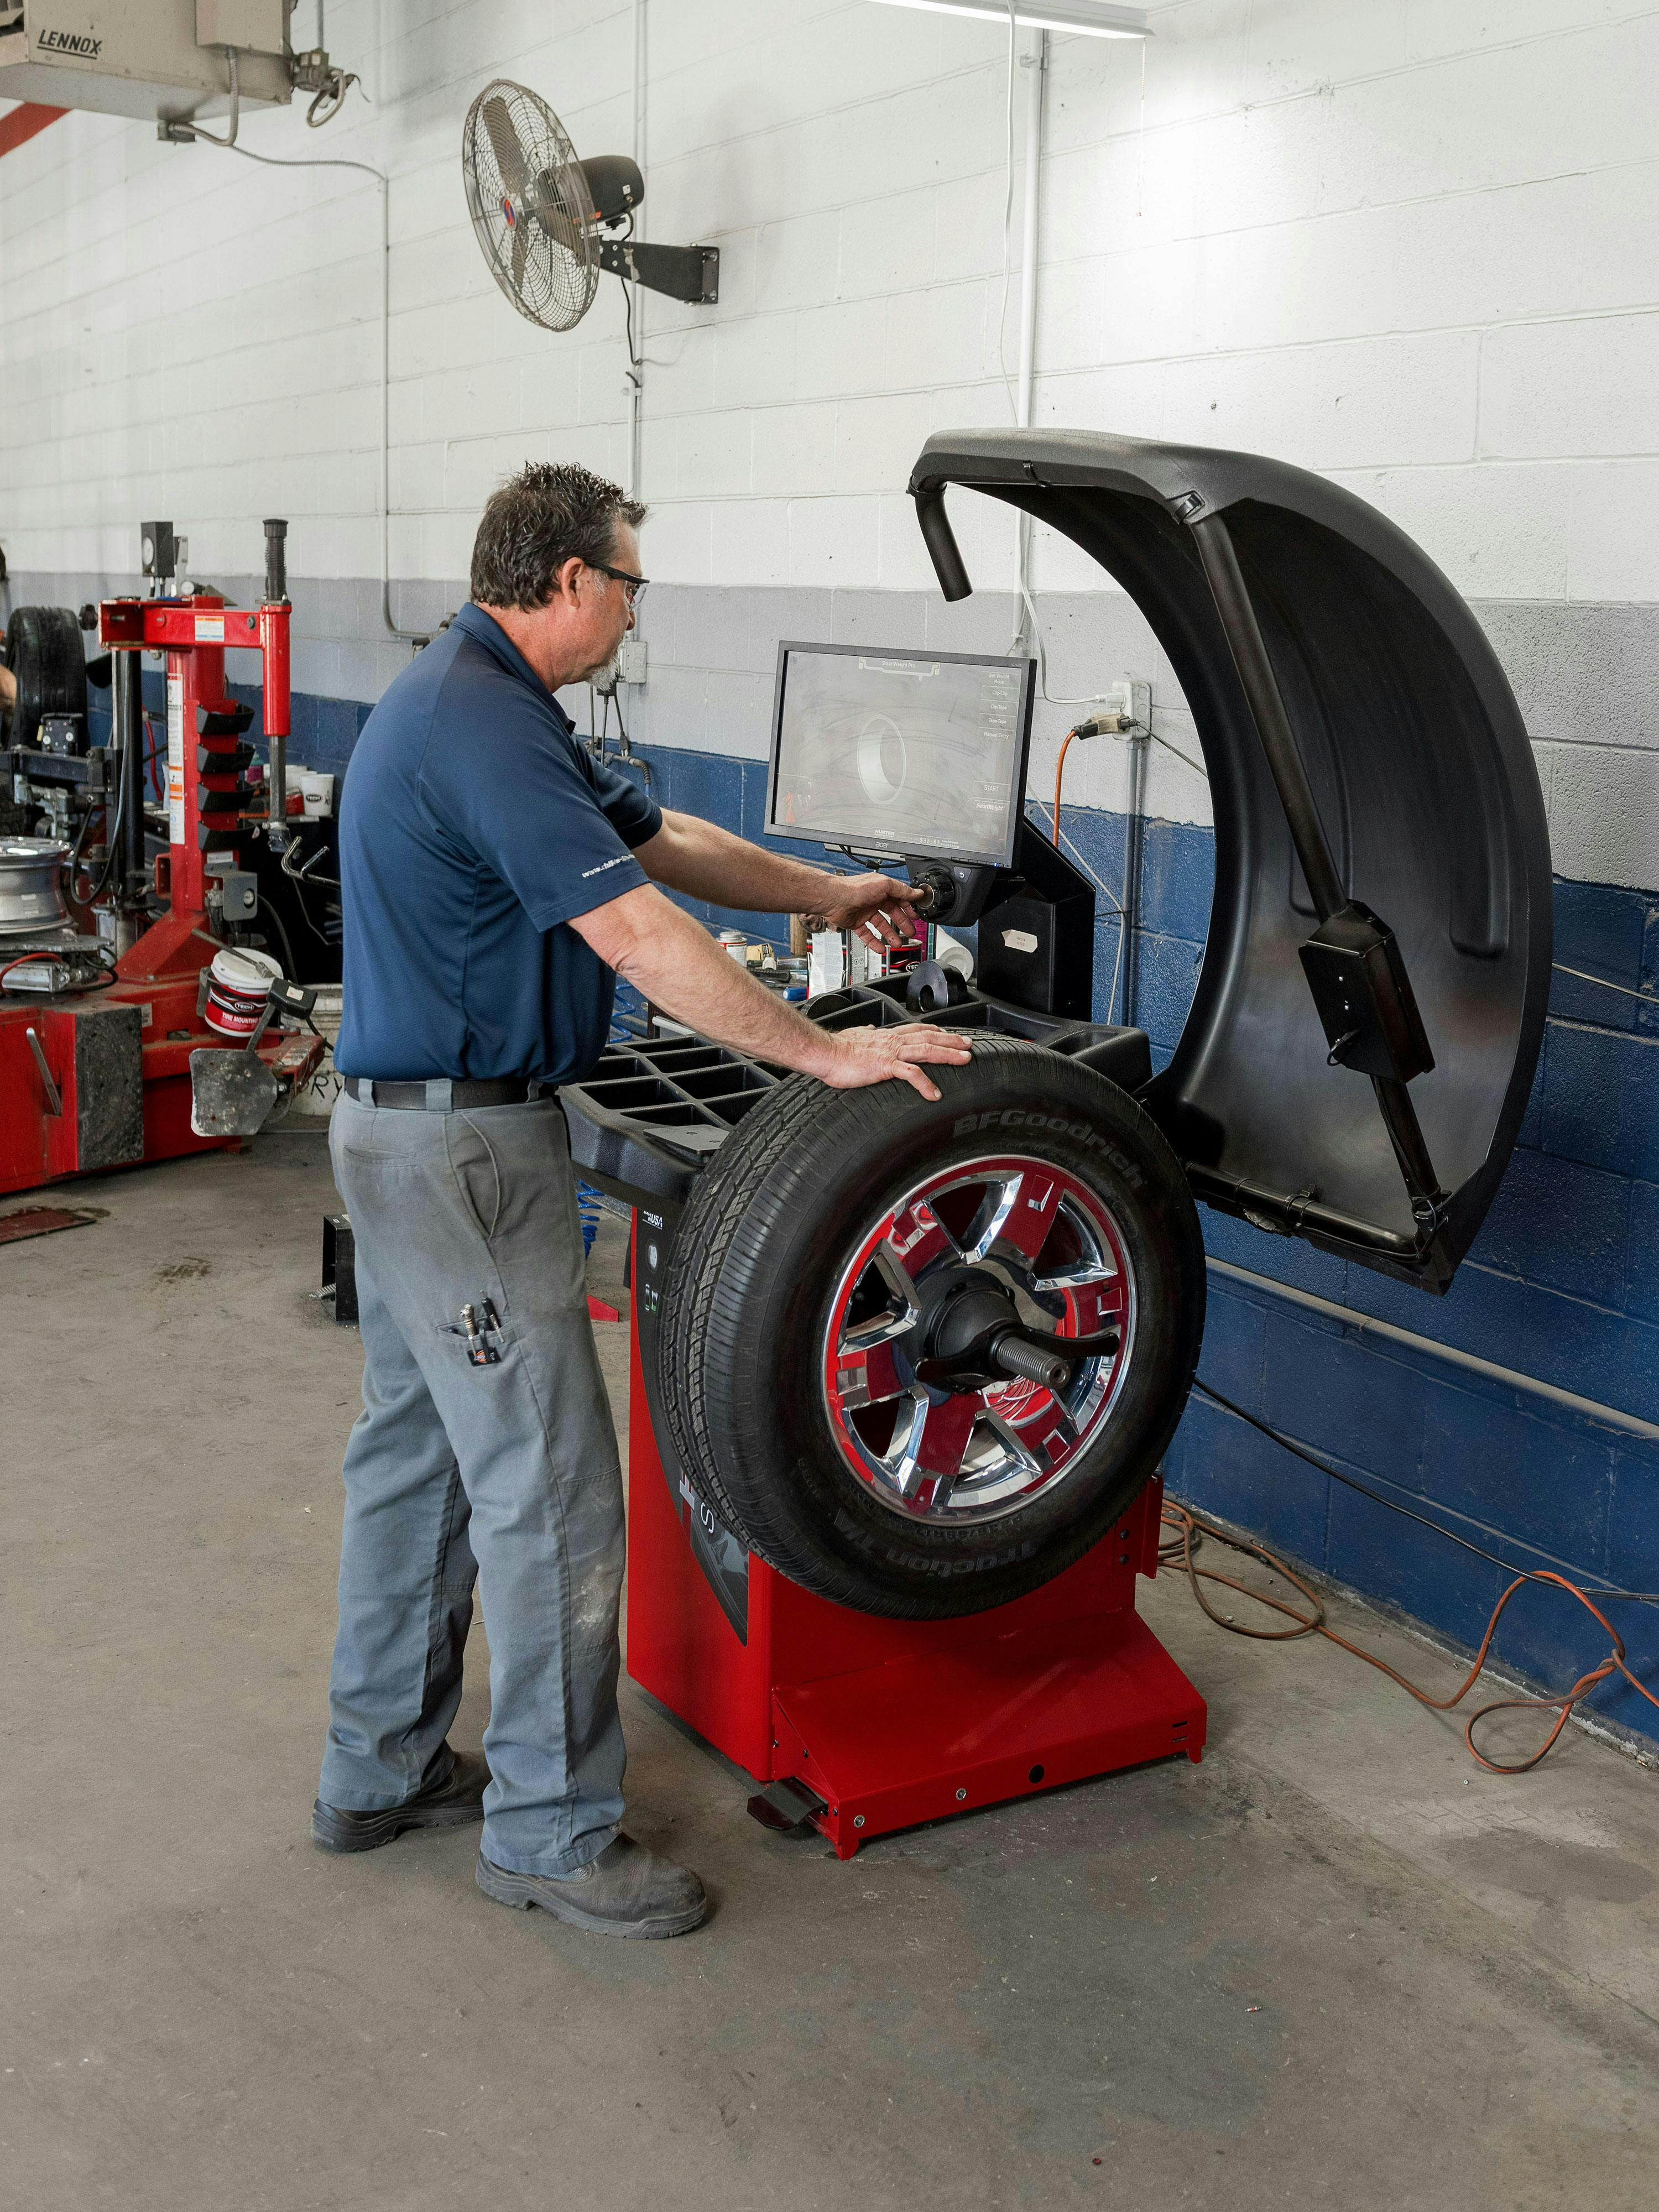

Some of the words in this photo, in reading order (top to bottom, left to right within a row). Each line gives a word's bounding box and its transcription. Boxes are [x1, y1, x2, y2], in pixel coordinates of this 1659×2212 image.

[38, 29, 102, 54] LENNOX
[976, 803, 1003, 811] SmartWeight
[306, 1074, 343, 1103] RY
[953, 1110, 1145, 1188] BFGoodrich
[651, 1214, 662, 1228] USA
[886, 1540, 1037, 1578] Traction
